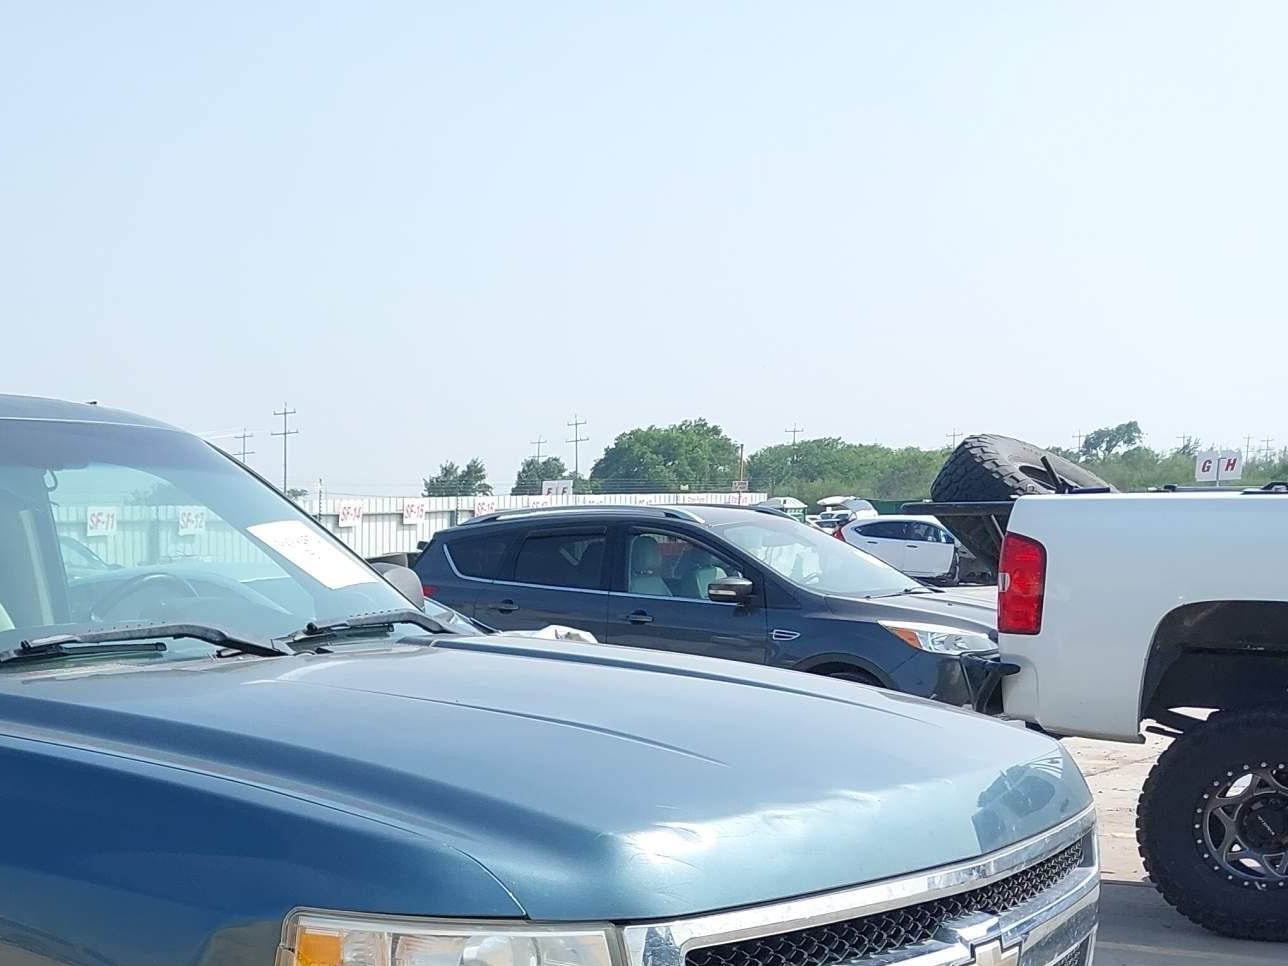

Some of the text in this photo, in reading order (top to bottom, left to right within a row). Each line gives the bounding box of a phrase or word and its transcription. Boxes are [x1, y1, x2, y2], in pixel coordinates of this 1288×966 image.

[1202, 459, 1212, 473] G
[1225, 458, 1237, 472] H
[341, 506, 362, 522] SF-14
[404, 503, 425, 519] SF-15
[88, 511, 115, 530] SF-11
[179, 511, 205, 529] SF-12
